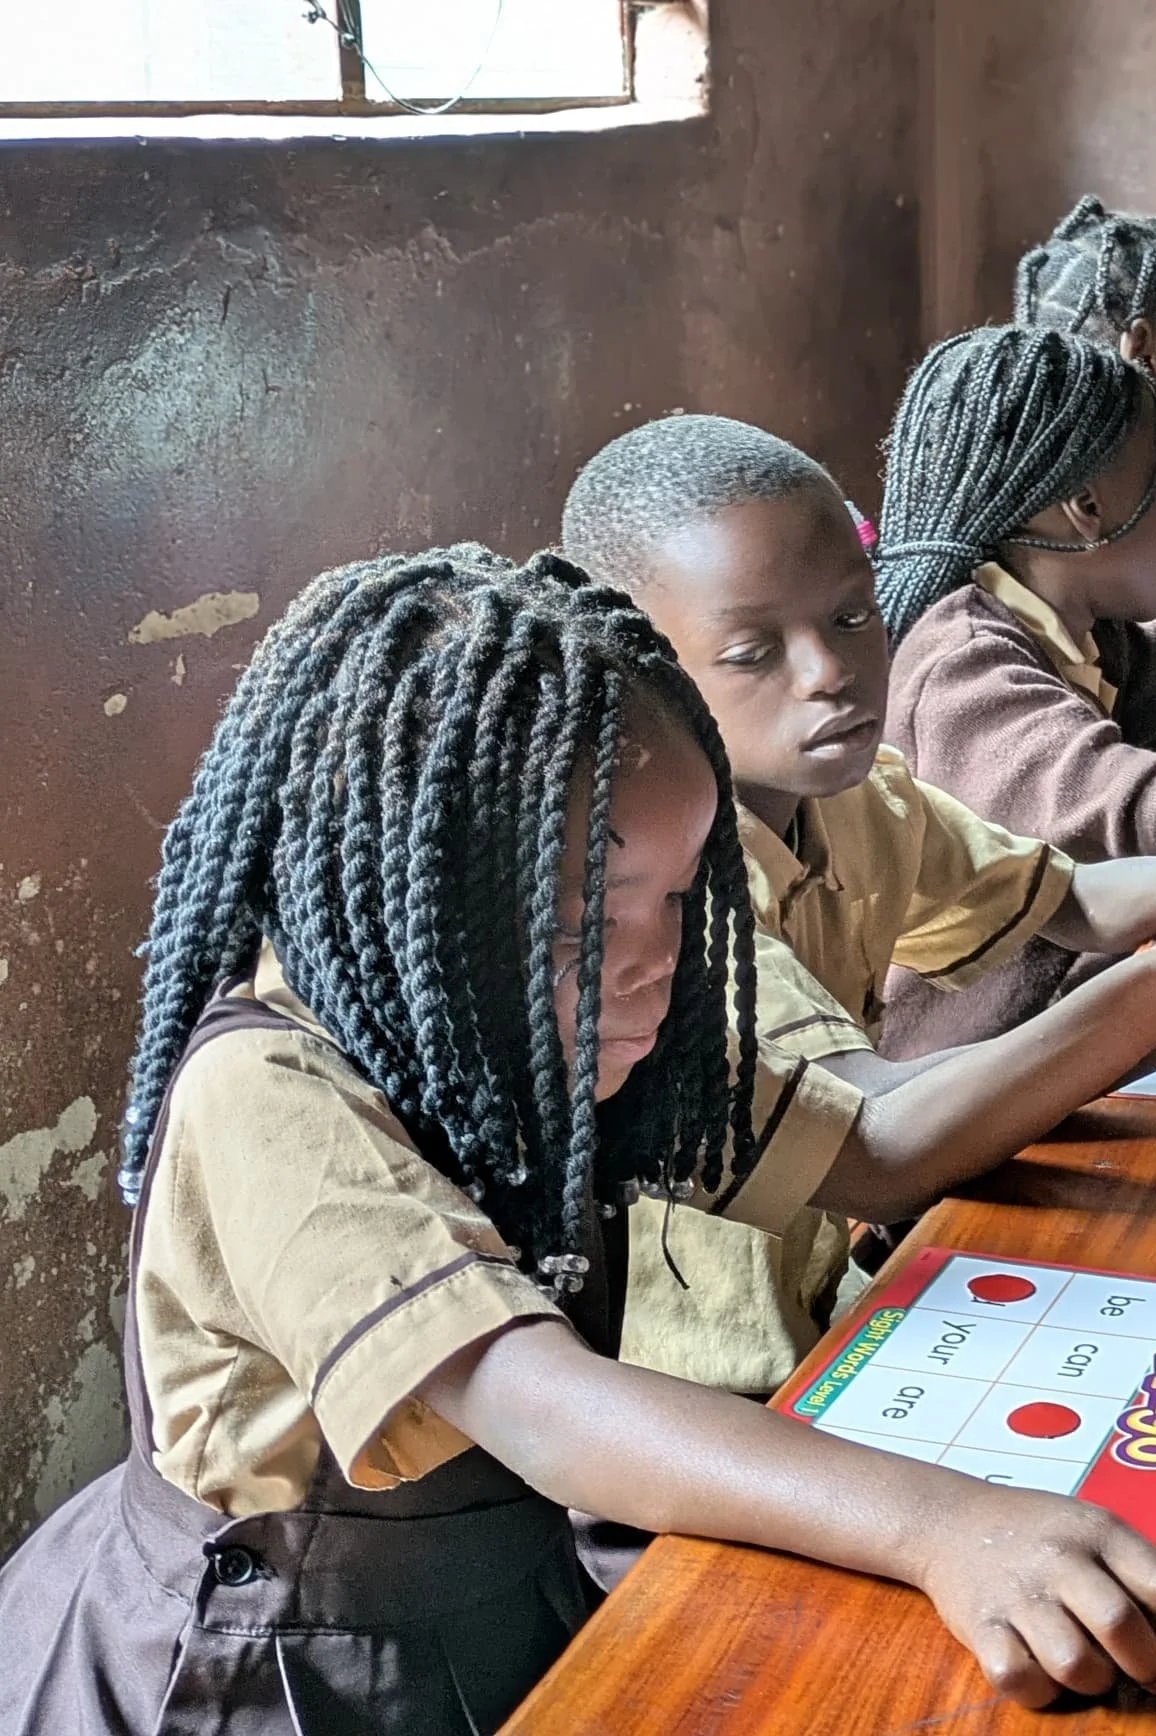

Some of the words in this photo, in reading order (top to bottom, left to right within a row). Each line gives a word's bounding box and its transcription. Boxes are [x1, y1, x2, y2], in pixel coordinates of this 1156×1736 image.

[1099, 1295, 1146, 1318] be
[865, 1310, 905, 1341] Sight
[927, 1320, 976, 1365] your
[831, 1341, 880, 1379] Words
[1056, 1343, 1098, 1378] can
[806, 1381, 843, 1407] Level
[882, 1385, 925, 1419] are
